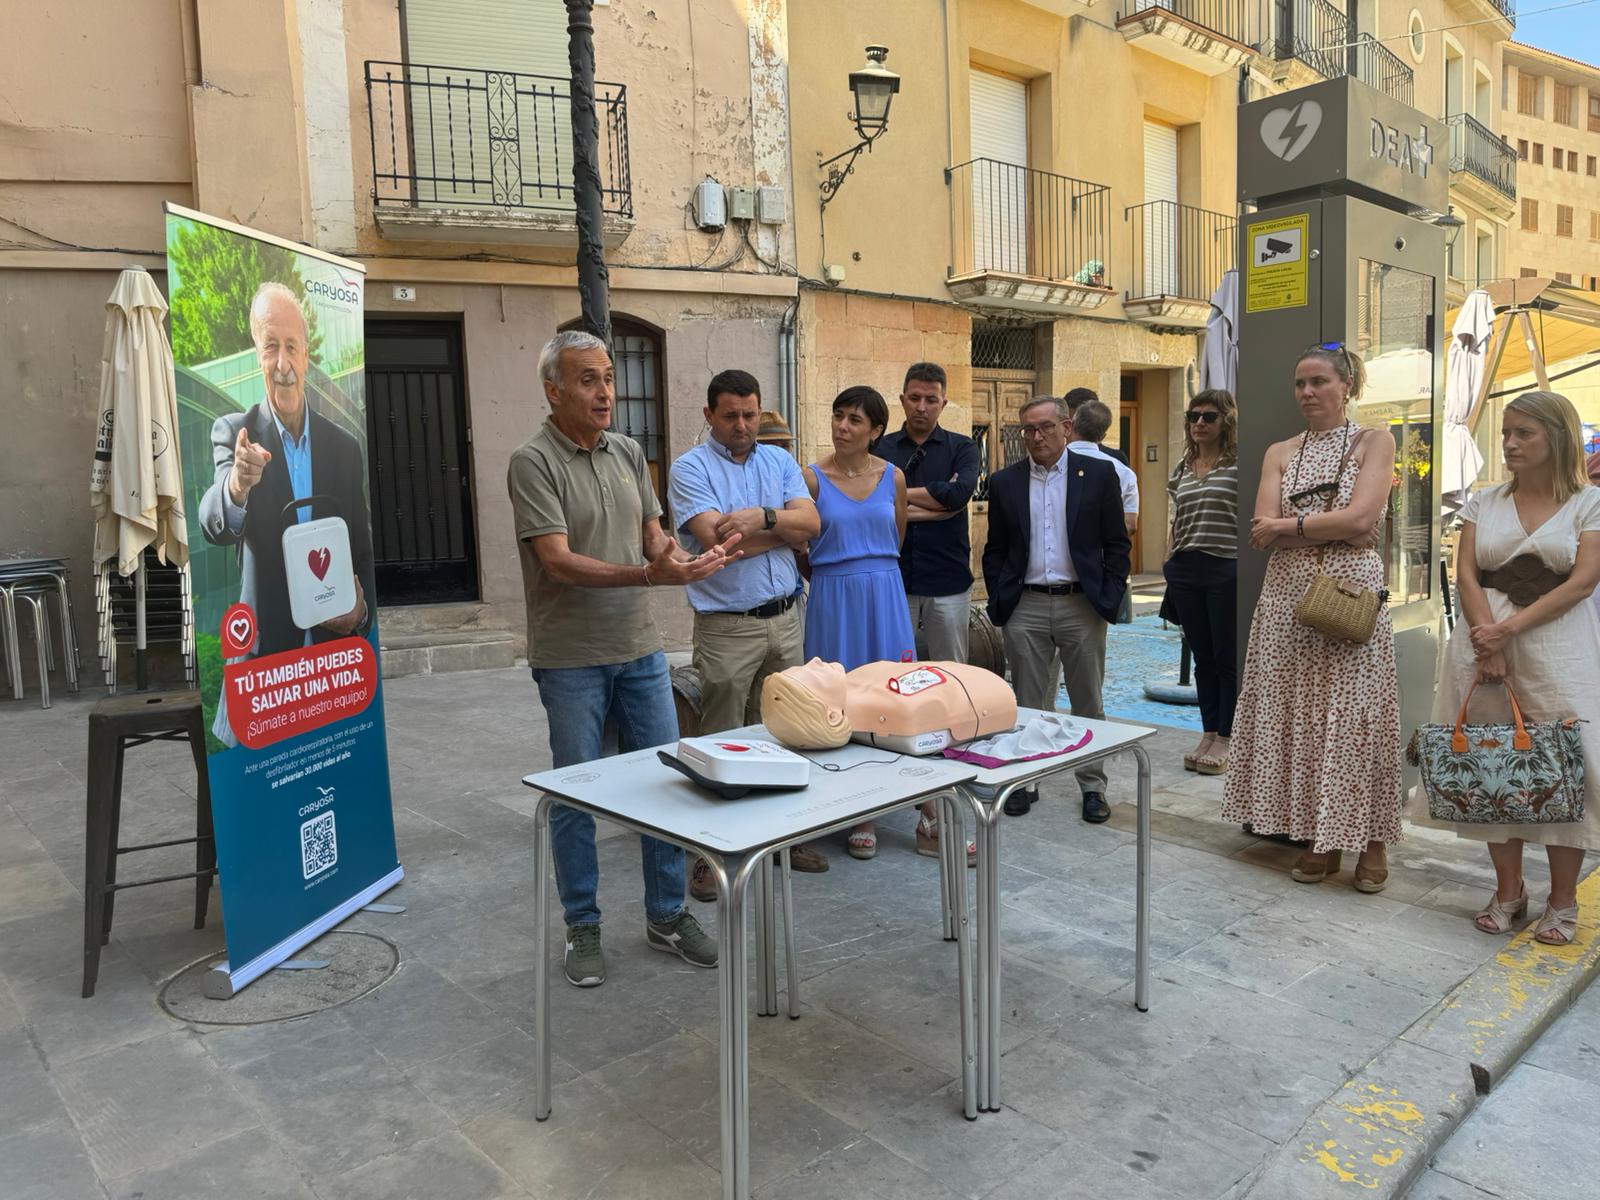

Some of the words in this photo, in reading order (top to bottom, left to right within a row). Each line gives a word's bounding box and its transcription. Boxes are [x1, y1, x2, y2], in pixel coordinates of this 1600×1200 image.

[1370, 117, 1413, 174] DEA
[304, 279, 359, 305] CARYOSA
[400, 288, 408, 299] 3
[234, 670, 255, 695] TÚ
[256, 657, 315, 689] TAMBIÉN
[317, 647, 364, 673] PUEDES
[251, 684, 302, 714] SALVAR
[304, 676, 330, 698] UNA
[331, 668, 365, 689] VIDA.
[247, 713, 288, 741] ¡Súmate
[289, 711, 297, 723] a
[298, 697, 333, 721] nuestro
[334, 686, 368, 709] equipo!
[271, 781, 279, 790] se
[304, 761, 323, 776] 30.000
[298, 793, 335, 817] CARYOSA
